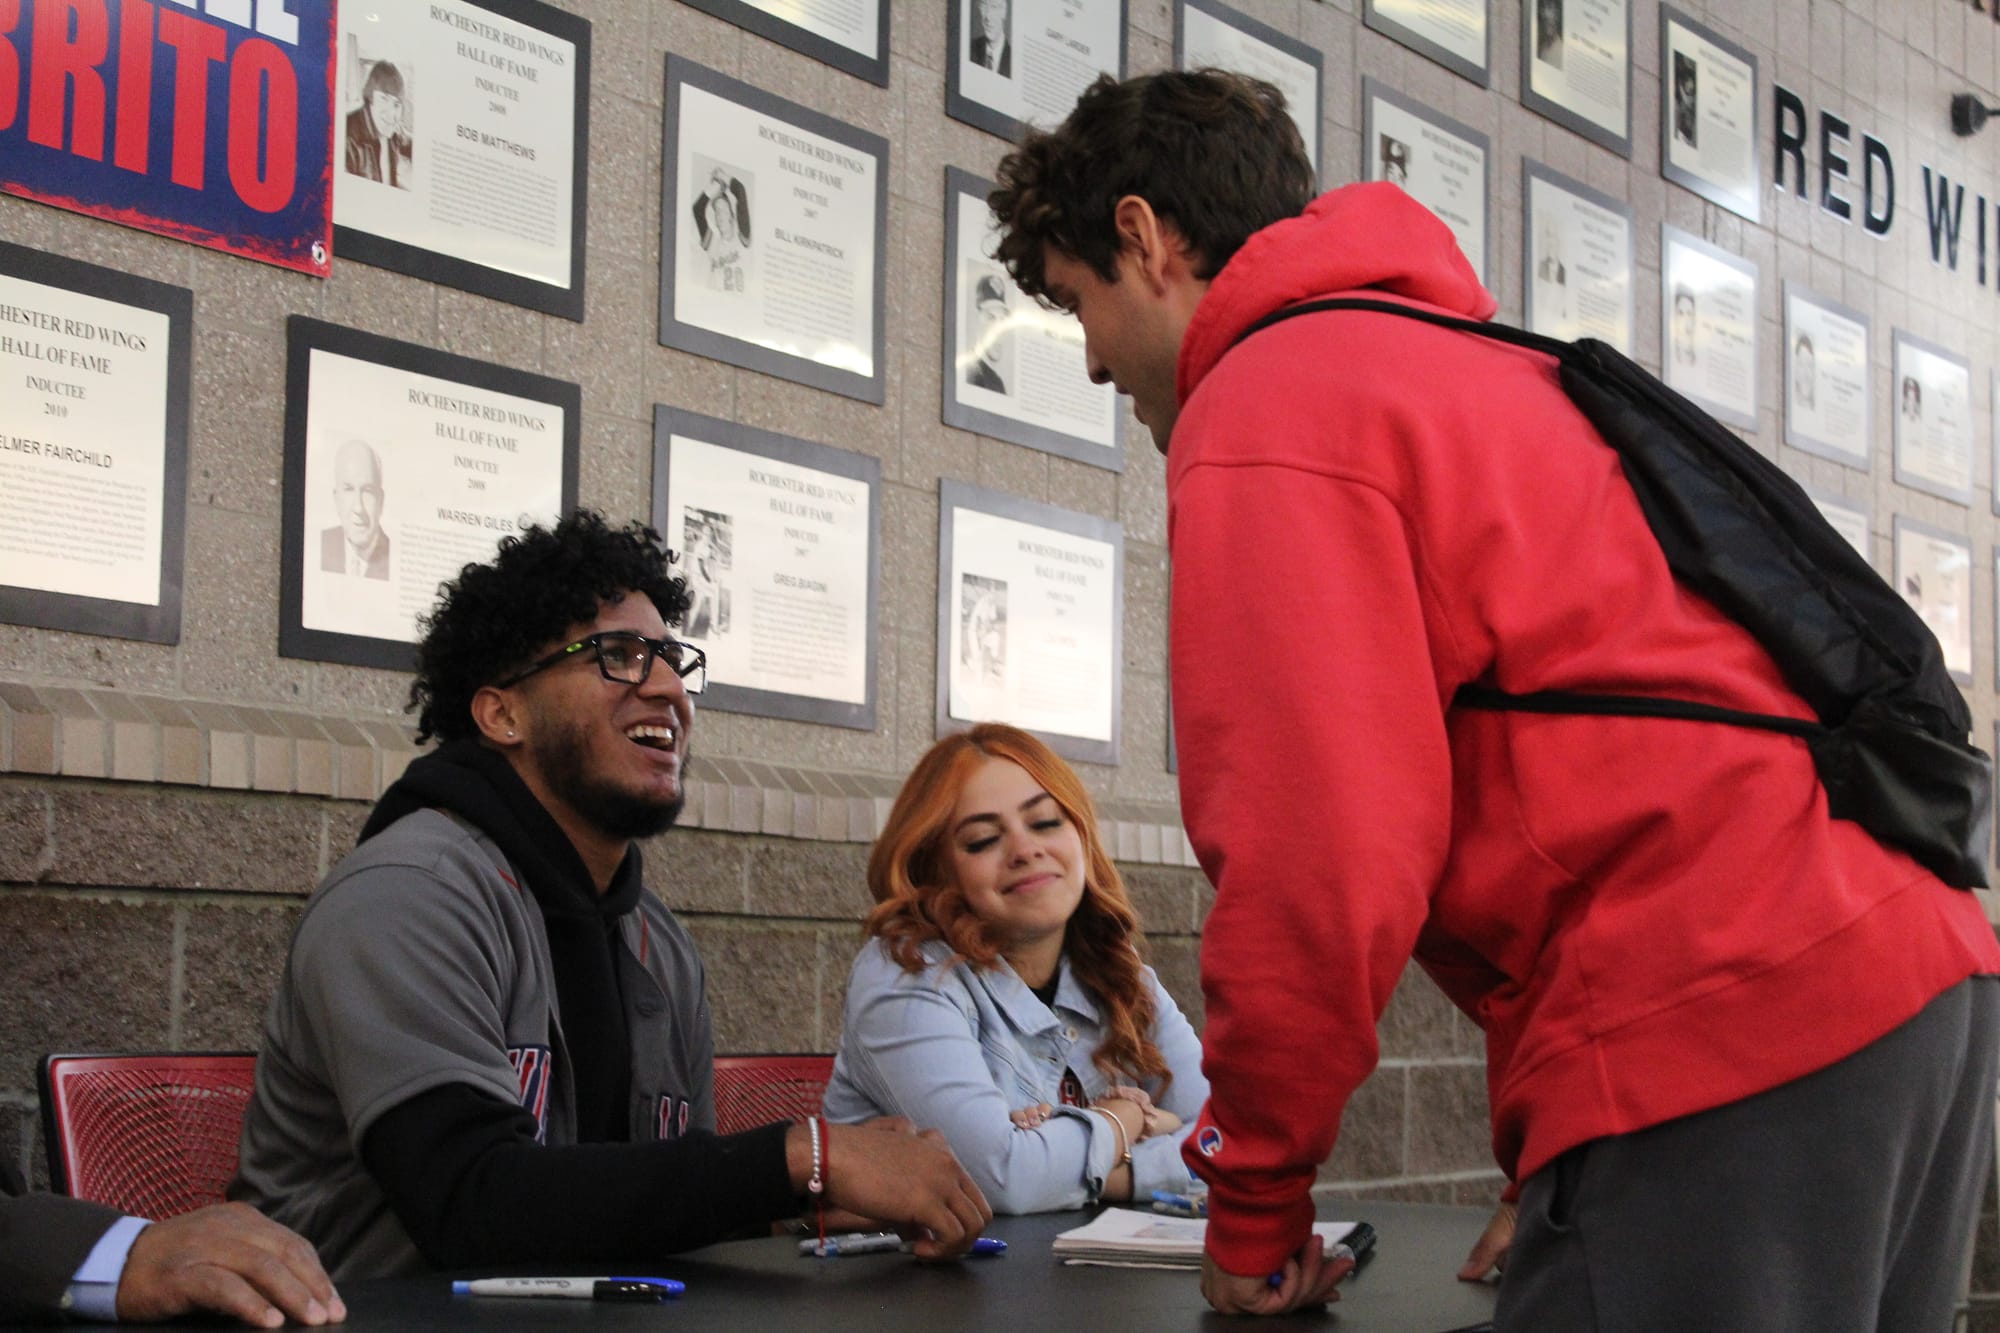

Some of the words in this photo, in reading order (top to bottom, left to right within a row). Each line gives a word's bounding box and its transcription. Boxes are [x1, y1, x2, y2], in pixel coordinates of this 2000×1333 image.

[430, 5, 500, 42] ROCHESTER
[503, 32, 526, 52] RED
[527, 41, 565, 65] WINGS
[456, 41, 487, 65] HALL
[490, 54, 504, 70] OF
[507, 60, 538, 82] FAME
[475, 76, 519, 101] INDUCTEE
[0, 0, 298, 213] RITO
[456, 124, 479, 142] BOB
[481, 132, 536, 161] MATTHEWS
[758, 124, 813, 155] ROCHESTER
[815, 146, 834, 163] RED
[835, 152, 865, 175] WINGS
[779, 156, 803, 176] HALL
[805, 166, 817, 180] OF
[819, 171, 843, 190] FAME
[1773, 83, 1895, 237] RED
[64, 319, 95, 340] RED
[98, 326, 147, 352] WINGS
[1, 336, 44, 360] HALL
[47, 346, 69, 365] OF
[71, 351, 112, 375] FAME
[26, 375, 87, 400] INDUCTEE
[44, 402, 68, 418] 2010
[408, 388, 480, 418] ROCHESTER
[482, 406, 506, 424] RED
[507, 411, 546, 432] WINGS
[435, 421, 468, 442] HALL
[469, 429, 485, 446] OF
[487, 433, 519, 453] FAME
[44, 443, 113, 469] FAIRCHILD
[453, 455, 499, 475] INDUCTEE
[749, 469, 805, 495] ROCHESTER
[806, 484, 825, 499] RED
[437, 507, 482, 527] WARREN
[484, 516, 513, 532] GILES
[770, 498, 793, 516] HALL
[810, 507, 835, 524] FAME
